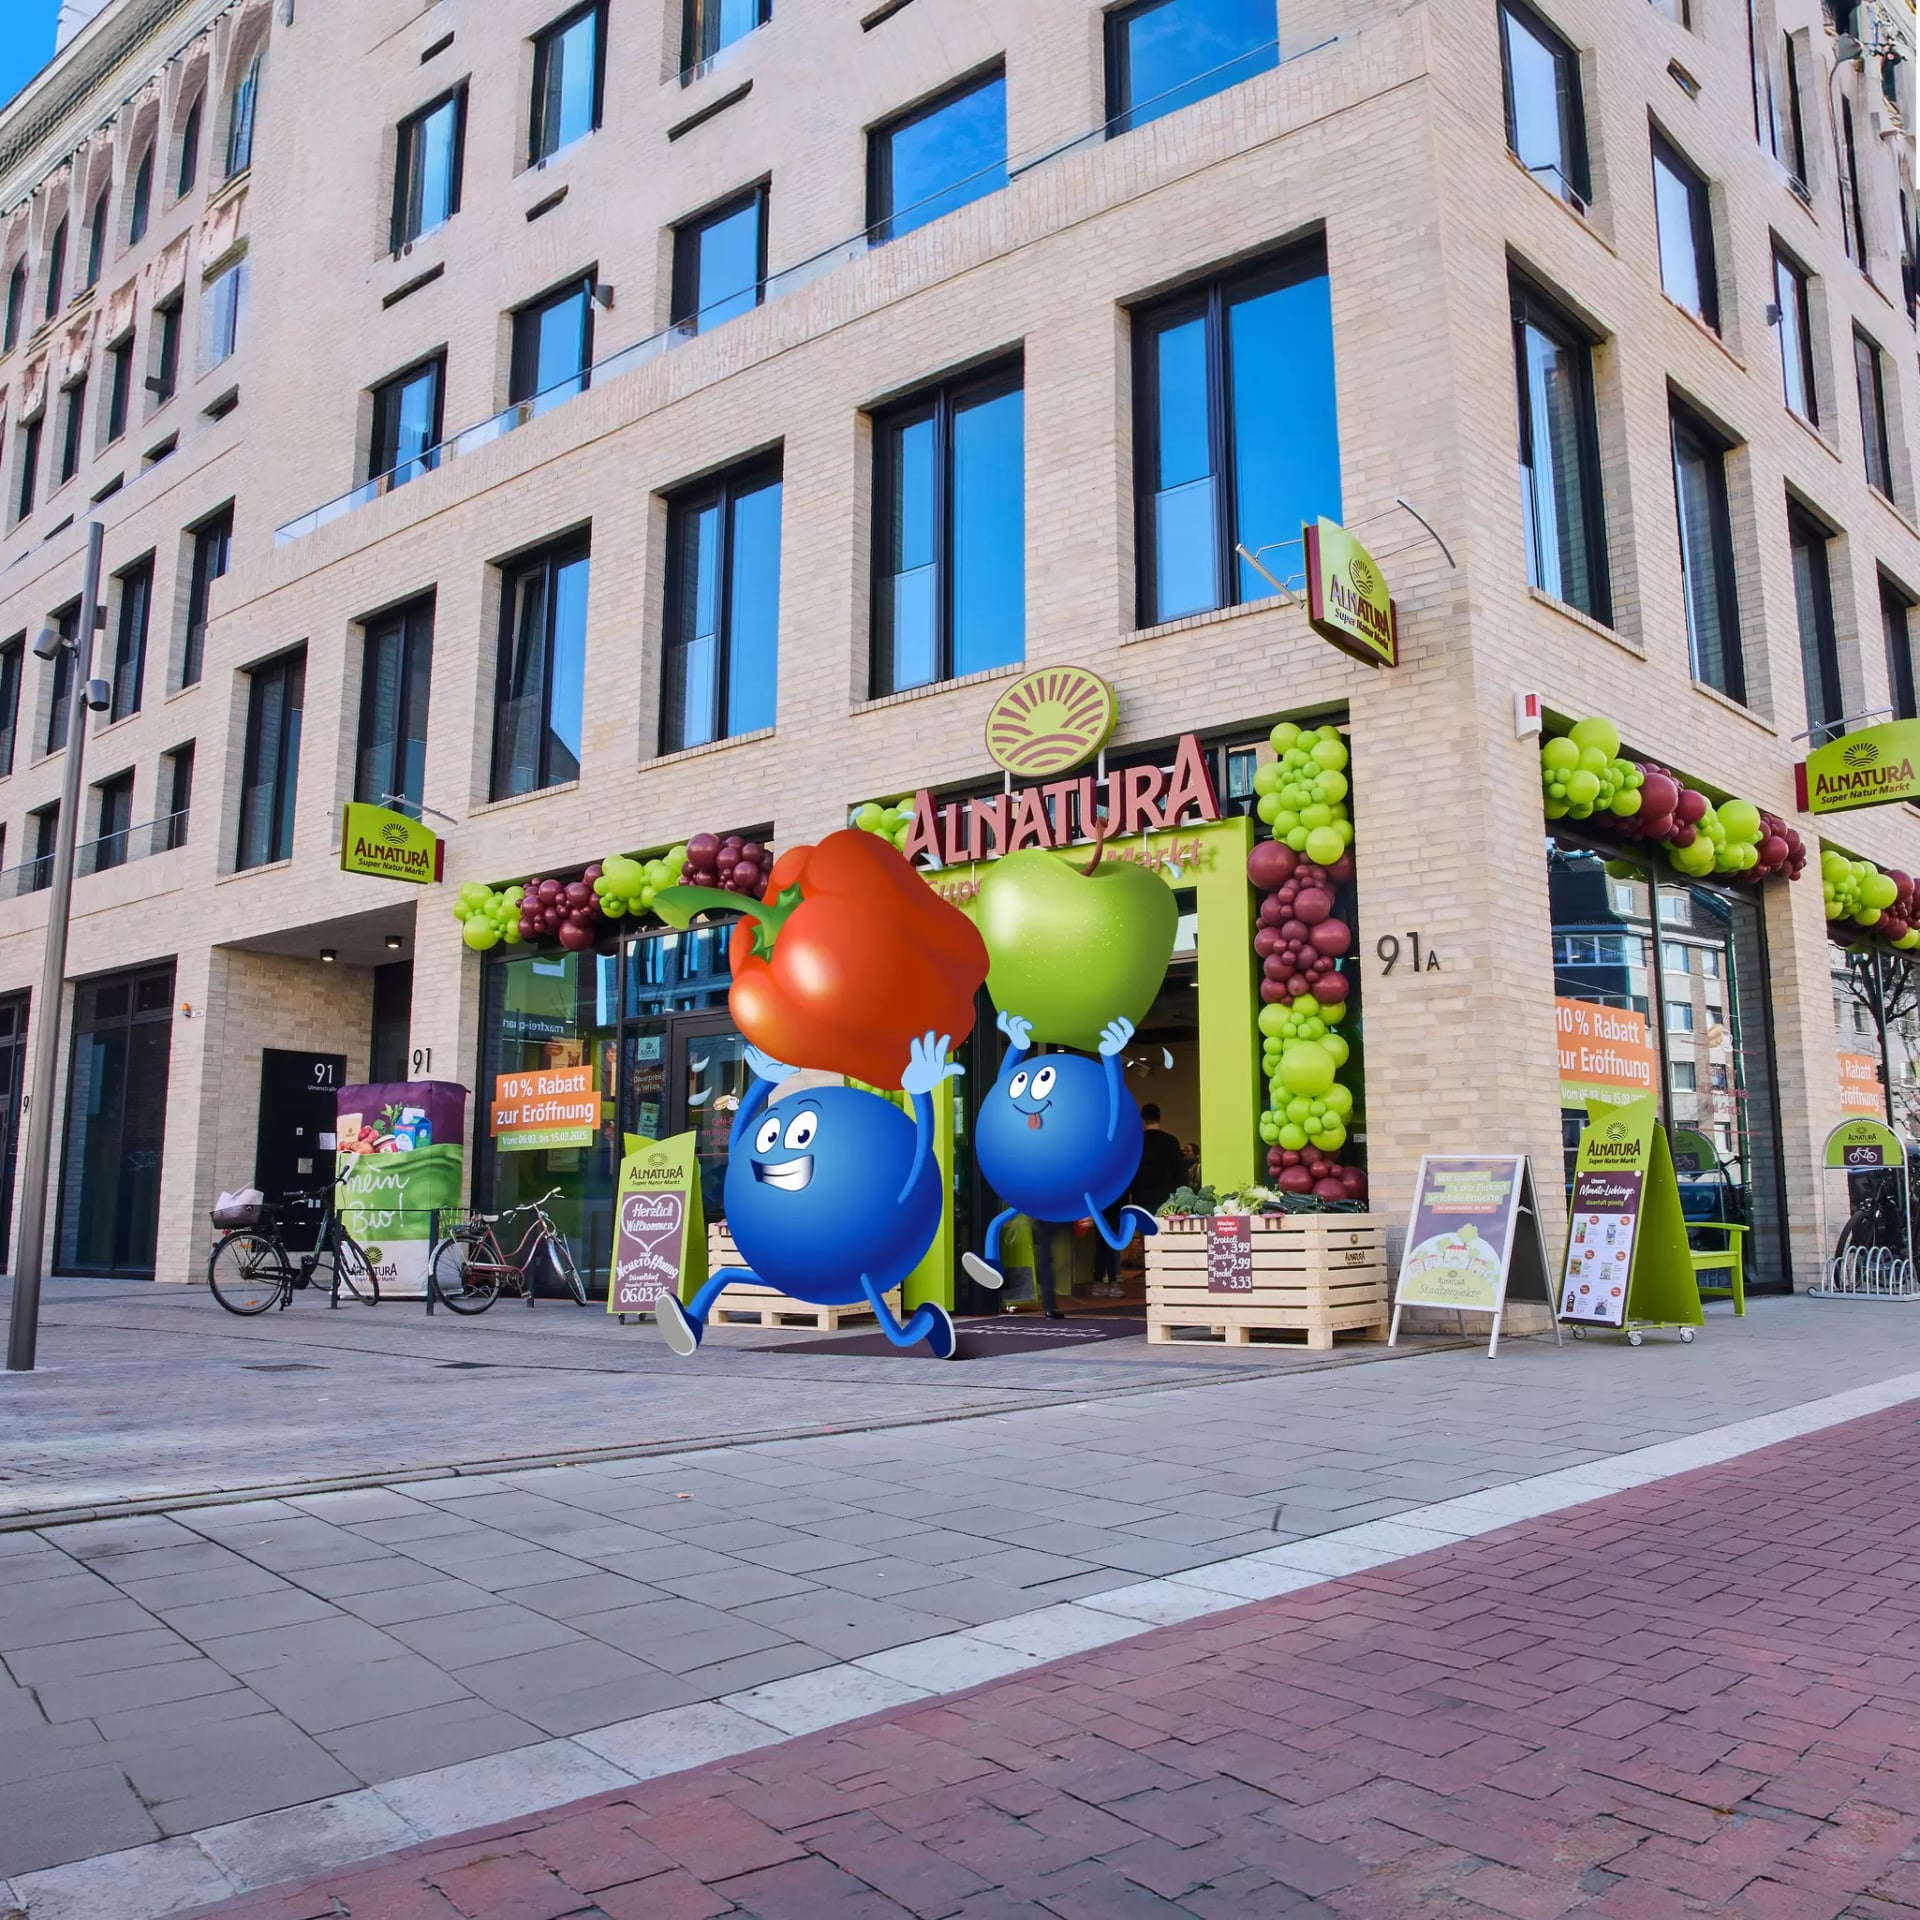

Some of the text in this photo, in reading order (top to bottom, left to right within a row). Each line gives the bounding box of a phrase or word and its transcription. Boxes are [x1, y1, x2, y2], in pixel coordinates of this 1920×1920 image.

[1330, 574, 1391, 641] ALNATURA
[1335, 608, 1356, 626] Super
[1816, 758, 1915, 796] ALNATURA
[902, 733, 1221, 867] ALNATURA
[1821, 783, 1910, 805] Super Natur Markt
[354, 837, 430, 868] ALNATURA
[358, 858, 426, 876] Super Natur Markt
[1556, 1006, 1640, 1044] 10 % Rabatt
[413, 1047, 432, 1074] 91
[1581, 1047, 1650, 1087] Eröffnung
[1845, 1060, 1872, 1080] Rabatt
[314, 1063, 334, 1084] 91
[502, 1073, 585, 1099] 10 % Rabatt
[496, 1100, 594, 1125] zur Eröffnung
[502, 1136, 518, 1146] Vom
[539, 1133, 549, 1143] bis
[1587, 1138, 1641, 1156] ALNATURA
[629, 1165, 683, 1180] ALNATURA
[632, 1202, 674, 1218] Herzlich
[626, 1219, 674, 1233] Willkommen
